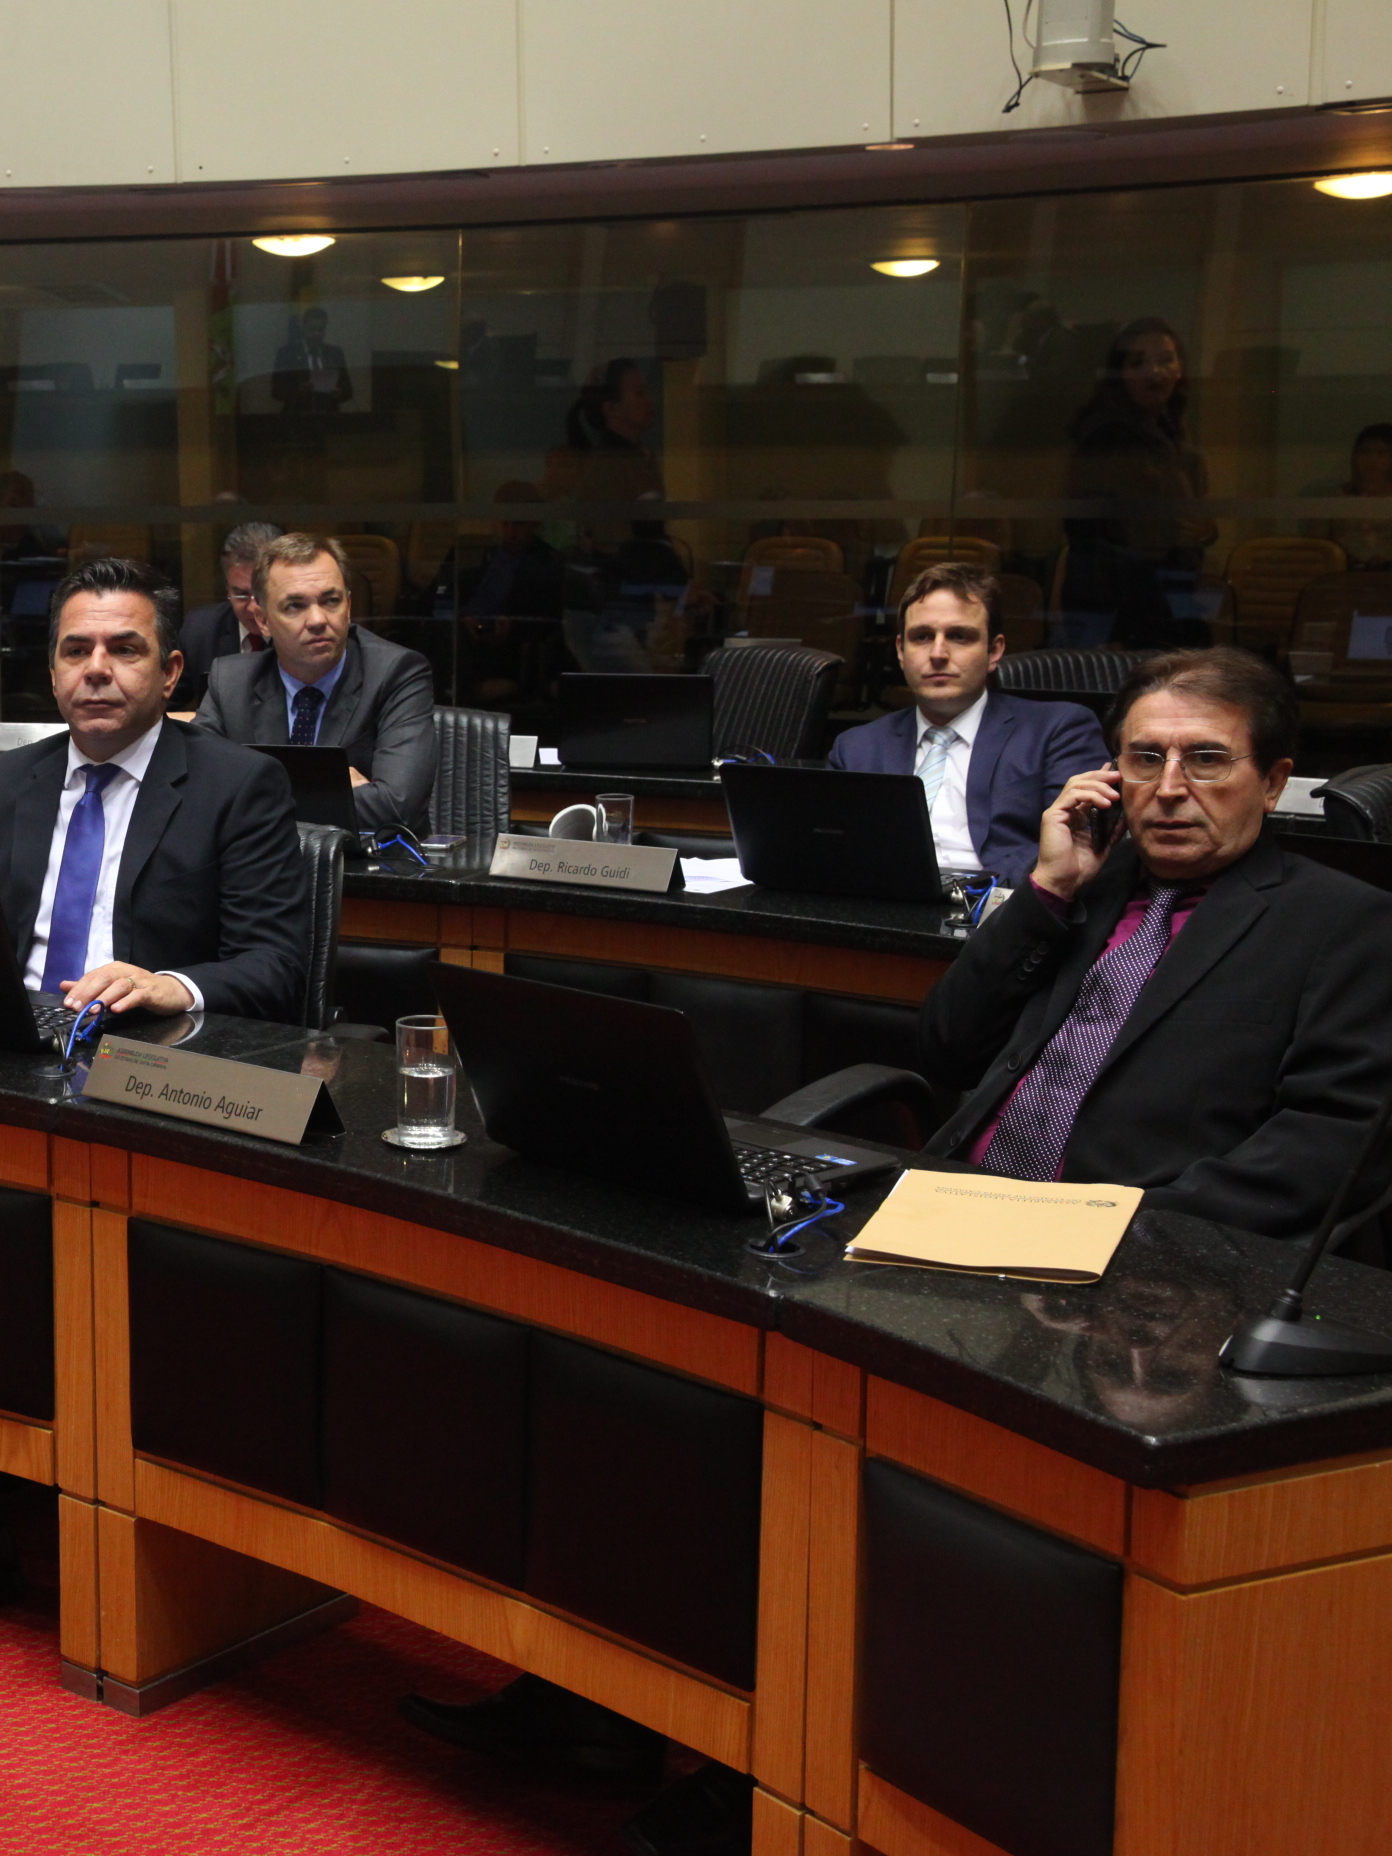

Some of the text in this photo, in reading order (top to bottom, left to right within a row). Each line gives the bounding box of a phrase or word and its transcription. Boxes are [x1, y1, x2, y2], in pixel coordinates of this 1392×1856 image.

[528, 858, 630, 879] Dep. Ricardo Guidi
[124, 1075, 263, 1121] Dep. Antonio Aguiar
